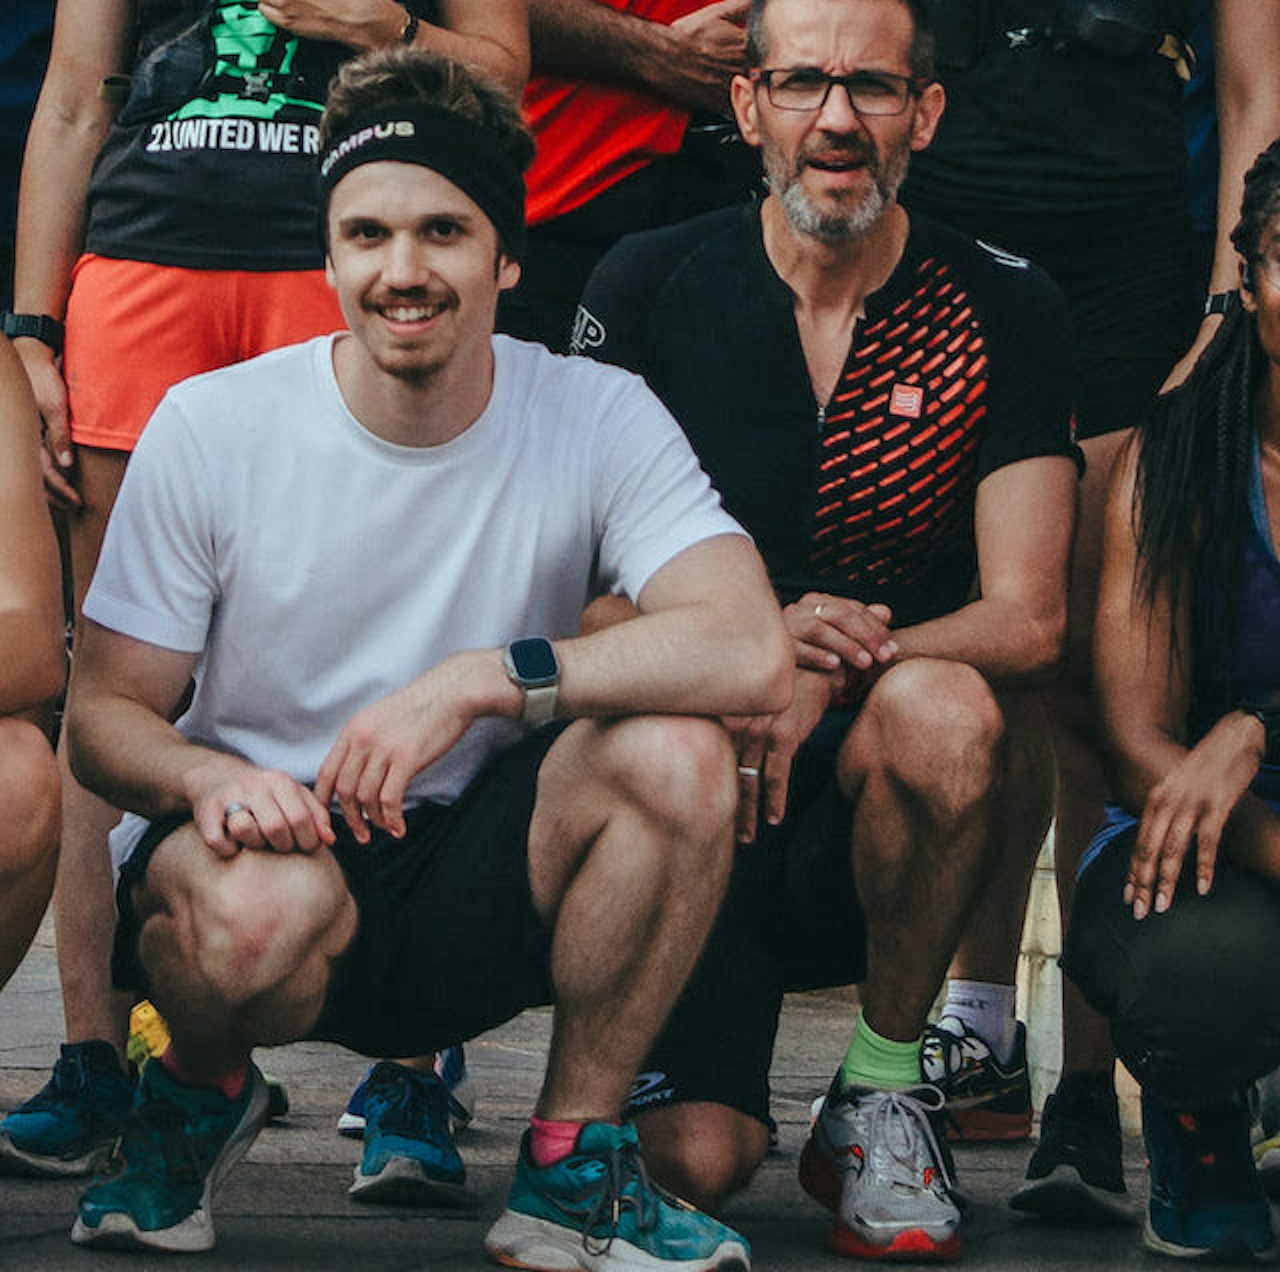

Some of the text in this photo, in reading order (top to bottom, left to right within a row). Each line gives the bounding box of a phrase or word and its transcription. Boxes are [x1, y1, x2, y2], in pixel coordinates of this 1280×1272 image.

[171, 118, 255, 150] UNITED
[258, 123, 299, 153] WE
[302, 125, 320, 155] R
[322, 121, 416, 177] CAMPUS
